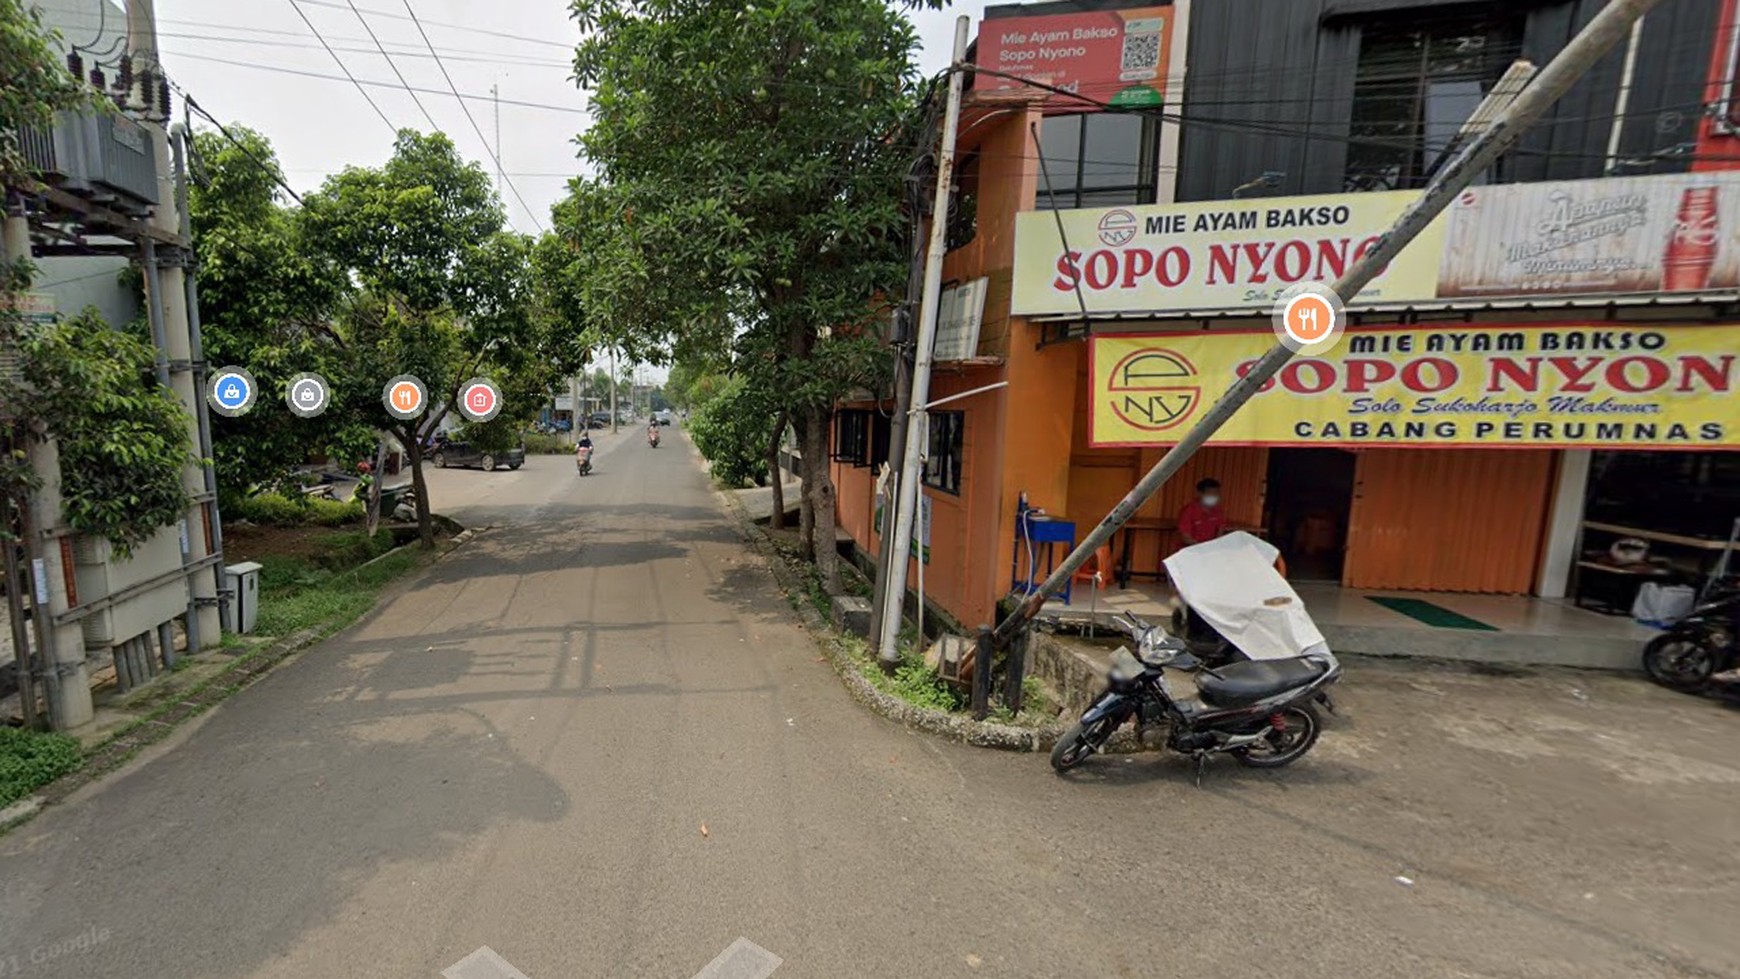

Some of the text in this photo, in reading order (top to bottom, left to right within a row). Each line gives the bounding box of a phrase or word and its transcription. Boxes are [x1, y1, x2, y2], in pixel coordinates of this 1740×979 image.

[1001, 27, 1119, 45] Mie Ayam Bakso
[1000, 49, 1036, 64] Sopo
[1145, 205, 1350, 234] MIE AYAM BAKSO
[1053, 246, 1191, 292] SOPO
[1349, 332, 1666, 353] MIE AYAM BAKSO
[1347, 396, 1661, 418] Solo Sukoharjo Makmur
[1294, 421, 1724, 440] CABANG PERUMNAS
